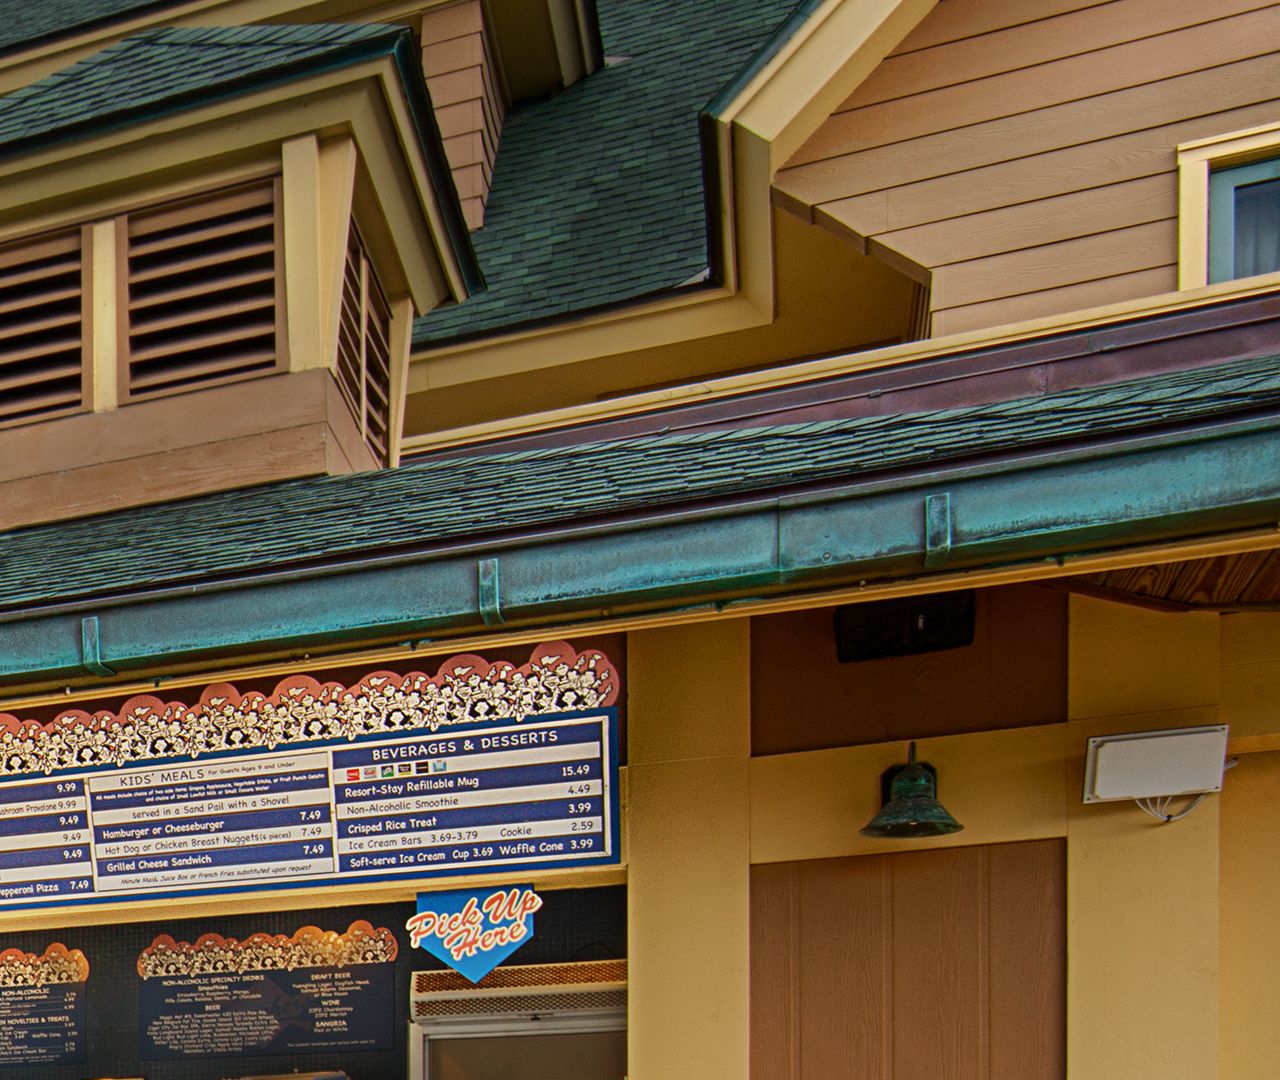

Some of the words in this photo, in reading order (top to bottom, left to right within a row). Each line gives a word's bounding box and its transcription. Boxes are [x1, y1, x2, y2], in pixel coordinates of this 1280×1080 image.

[372, 741, 456, 761] BEVERAGES
[463, 739, 474, 751] &
[481, 731, 558, 750] DESSERTS
[57, 783, 76, 792] 9.99
[161, 769, 205, 783] MEALS
[344, 780, 403, 798] Resort-Stay
[407, 777, 454, 790] Refillable
[457, 776, 479, 789] Mug
[562, 764, 590, 777] 15.49
[26, 803, 57, 813] Provolone
[58, 801, 76, 810] 9.99
[132, 807, 159, 819] served
[163, 806, 171, 816] in
[183, 802, 204, 814] Sand
[208, 800, 224, 811] Pail
[228, 799, 248, 810] with
[261, 795, 290, 807] Shovel
[347, 801, 411, 815] Non-Alcoholic
[415, 797, 459, 809] Smoothie
[568, 783, 590, 795] 4.49
[60, 816, 78, 825] 9.49
[103, 826, 149, 840] Hamburger
[152, 826, 162, 834] or
[165, 819, 224, 834] Cheeseburger
[300, 810, 321, 821] 7.49
[348, 820, 382, 836] Crisped
[386, 818, 406, 831] Rice
[410, 817, 437, 828] Treat
[568, 802, 591, 814] 3.99
[63, 833, 81, 842] 9.49
[105, 846, 119, 856] Hot
[123, 844, 140, 855] Dog
[143, 844, 152, 852] or
[155, 838, 187, 850] Chicken
[191, 836, 220, 846] Breast
[301, 826, 322, 837] 7.49
[349, 840, 364, 850] Ice
[368, 836, 397, 849] Cream
[401, 836, 422, 846] Bars
[500, 826, 532, 837] Cookie
[572, 820, 593, 831] 2.59
[64, 849, 82, 859] 9.49
[107, 861, 135, 873] Grilled
[138, 858, 168, 869] Cheese
[171, 854, 211, 867] Sandwich
[303, 844, 324, 855] 7.49
[350, 855, 396, 868] Soft-serve
[400, 853, 414, 864] Ice
[417, 850, 445, 861] Cream
[453, 848, 470, 861] Cup
[473, 846, 493, 858] 3.69
[500, 843, 535, 856] Waffle
[539, 841, 564, 852] Cone
[570, 838, 593, 850] 3.99
[36, 883, 59, 894] Pizza
[70, 880, 88, 890] 7.49
[406, 897, 484, 949] Pick
[482, 888, 543, 924] Up
[443, 921, 528, 961] Here
